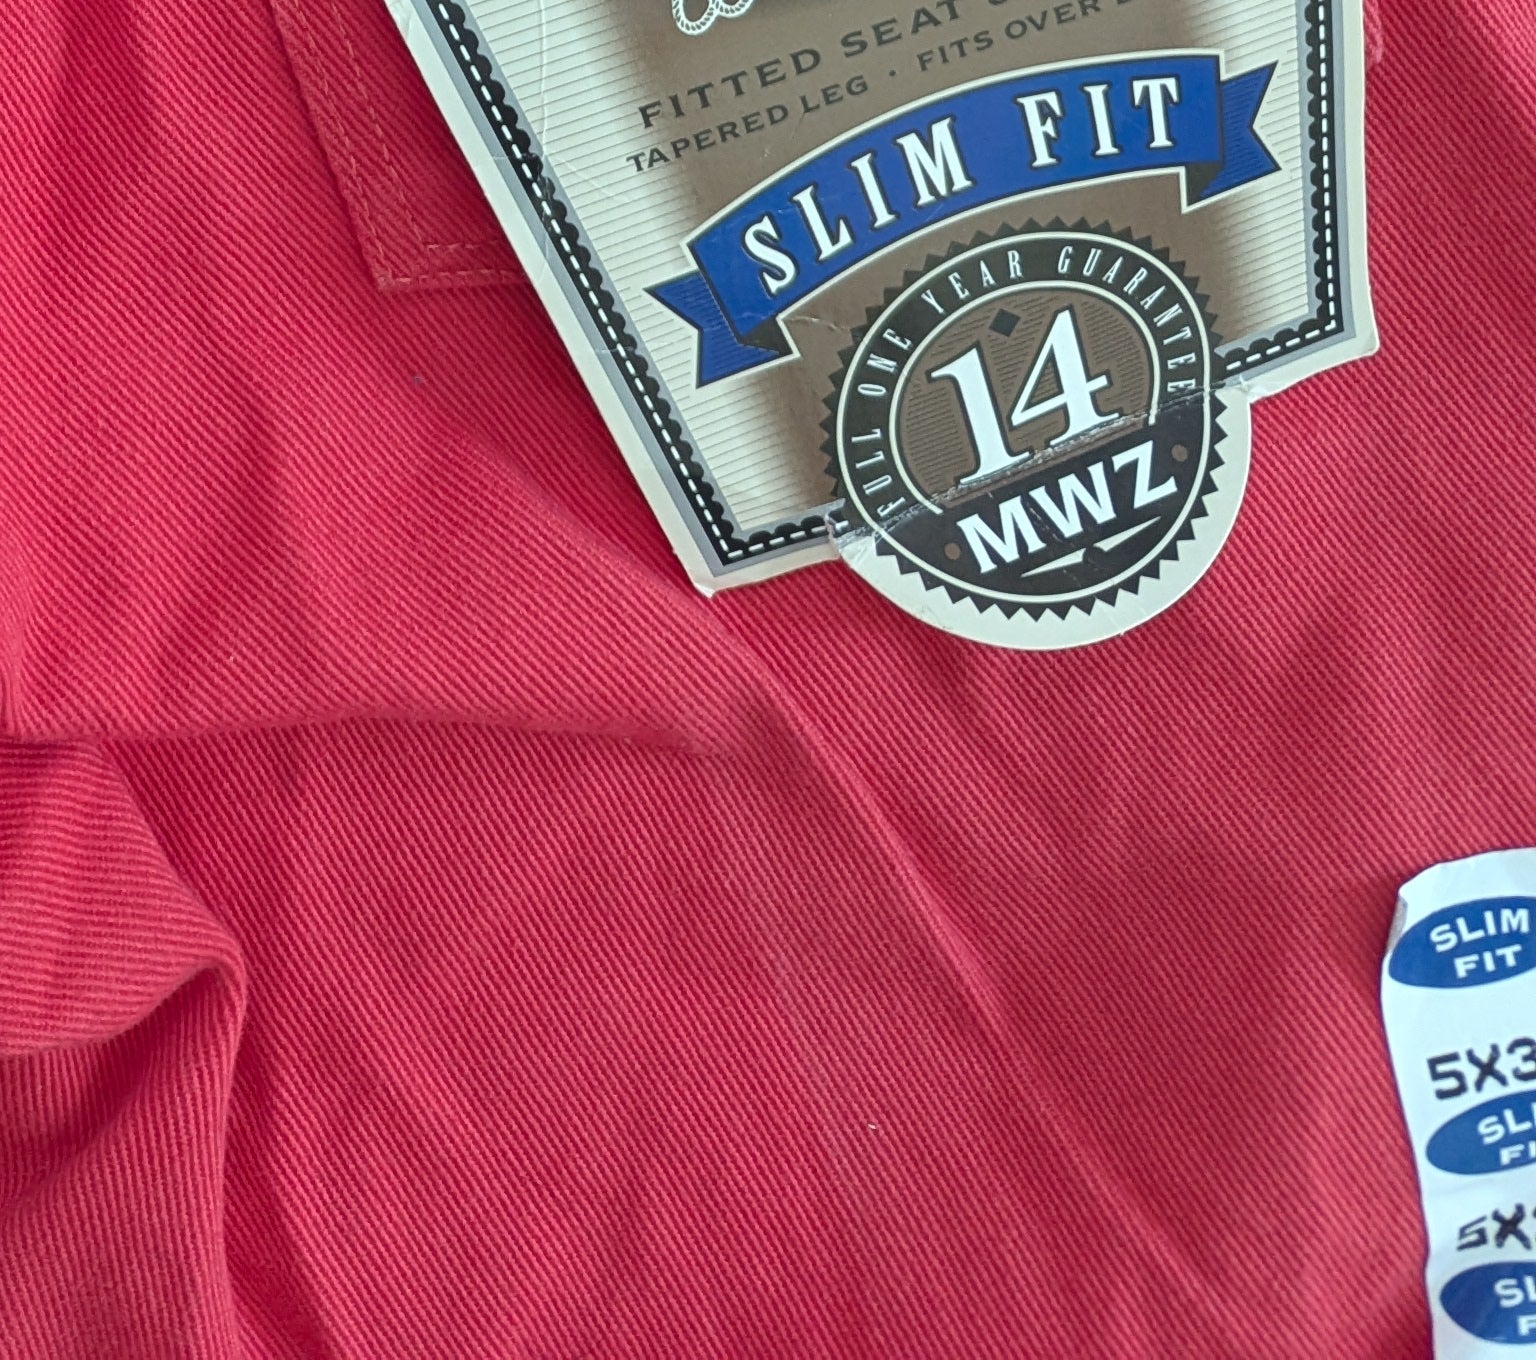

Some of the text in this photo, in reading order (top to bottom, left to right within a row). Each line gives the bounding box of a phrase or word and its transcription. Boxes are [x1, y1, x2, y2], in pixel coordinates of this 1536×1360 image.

[626, 103, 790, 173] TAPERED
[799, 75, 869, 114] LEG
[916, 30, 994, 72] FITS
[638, 48, 821, 129] FITTED
[741, 76, 1181, 295] SLIM FIT
[851, 245, 1197, 519] FULL ONE YEAR GUARANTEE
[930, 308, 1121, 484] 14
[956, 440, 1178, 575] MWZ
[1429, 907, 1530, 953] SLIM
[1453, 944, 1523, 979] FIT
[1456, 1202, 1536, 1252] 5X
